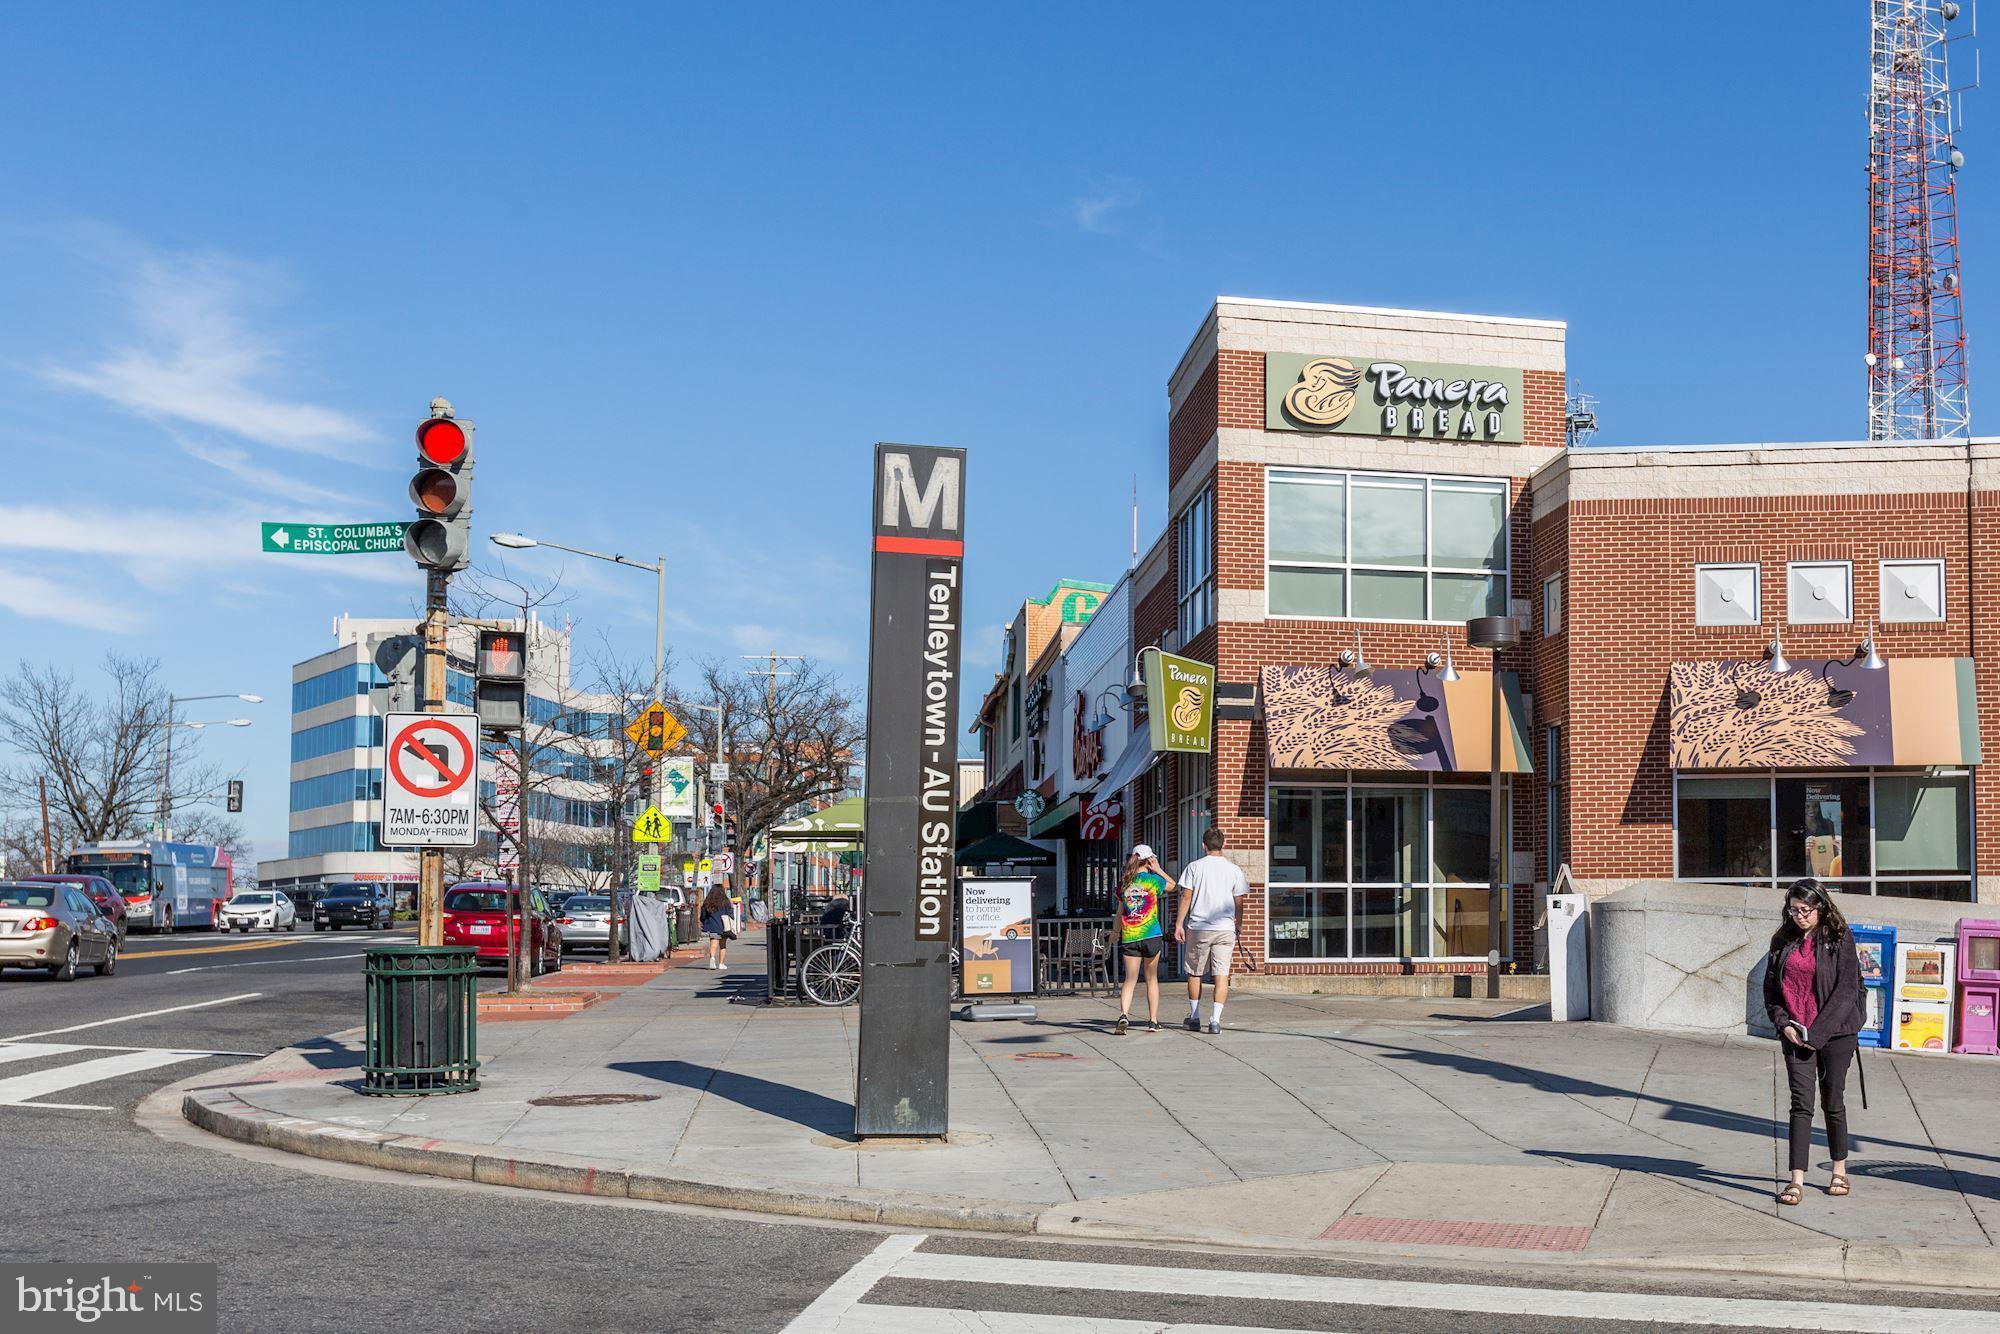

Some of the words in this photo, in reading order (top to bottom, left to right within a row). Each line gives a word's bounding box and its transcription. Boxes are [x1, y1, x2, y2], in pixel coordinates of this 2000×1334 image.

[1368, 362, 1509, 405] Panera
[1384, 405, 1501, 435] BREAD
[882, 452, 960, 531] M
[308, 526, 328, 539] ST.
[334, 525, 403, 539] COLUMBA'S
[293, 538, 361, 552] EPISCOPAL
[364, 537, 405, 550] CHURC
[923, 565, 957, 746] Tenleytown
[1168, 664, 1208, 686] Panera
[1171, 732, 1206, 748] BREAD
[921, 766, 950, 812] AU
[1806, 793, 1841, 801] Delivering
[389, 808, 469, 825] 7AM-6:30PM
[389, 827, 469, 837] MONDAY-FRIDAY
[919, 821, 950, 936] Station
[965, 887, 986, 896] Now
[965, 896, 1011, 906] delivering
[965, 905, 974, 913] to
[976, 905, 1001, 913] home
[965, 914, 974, 922] or
